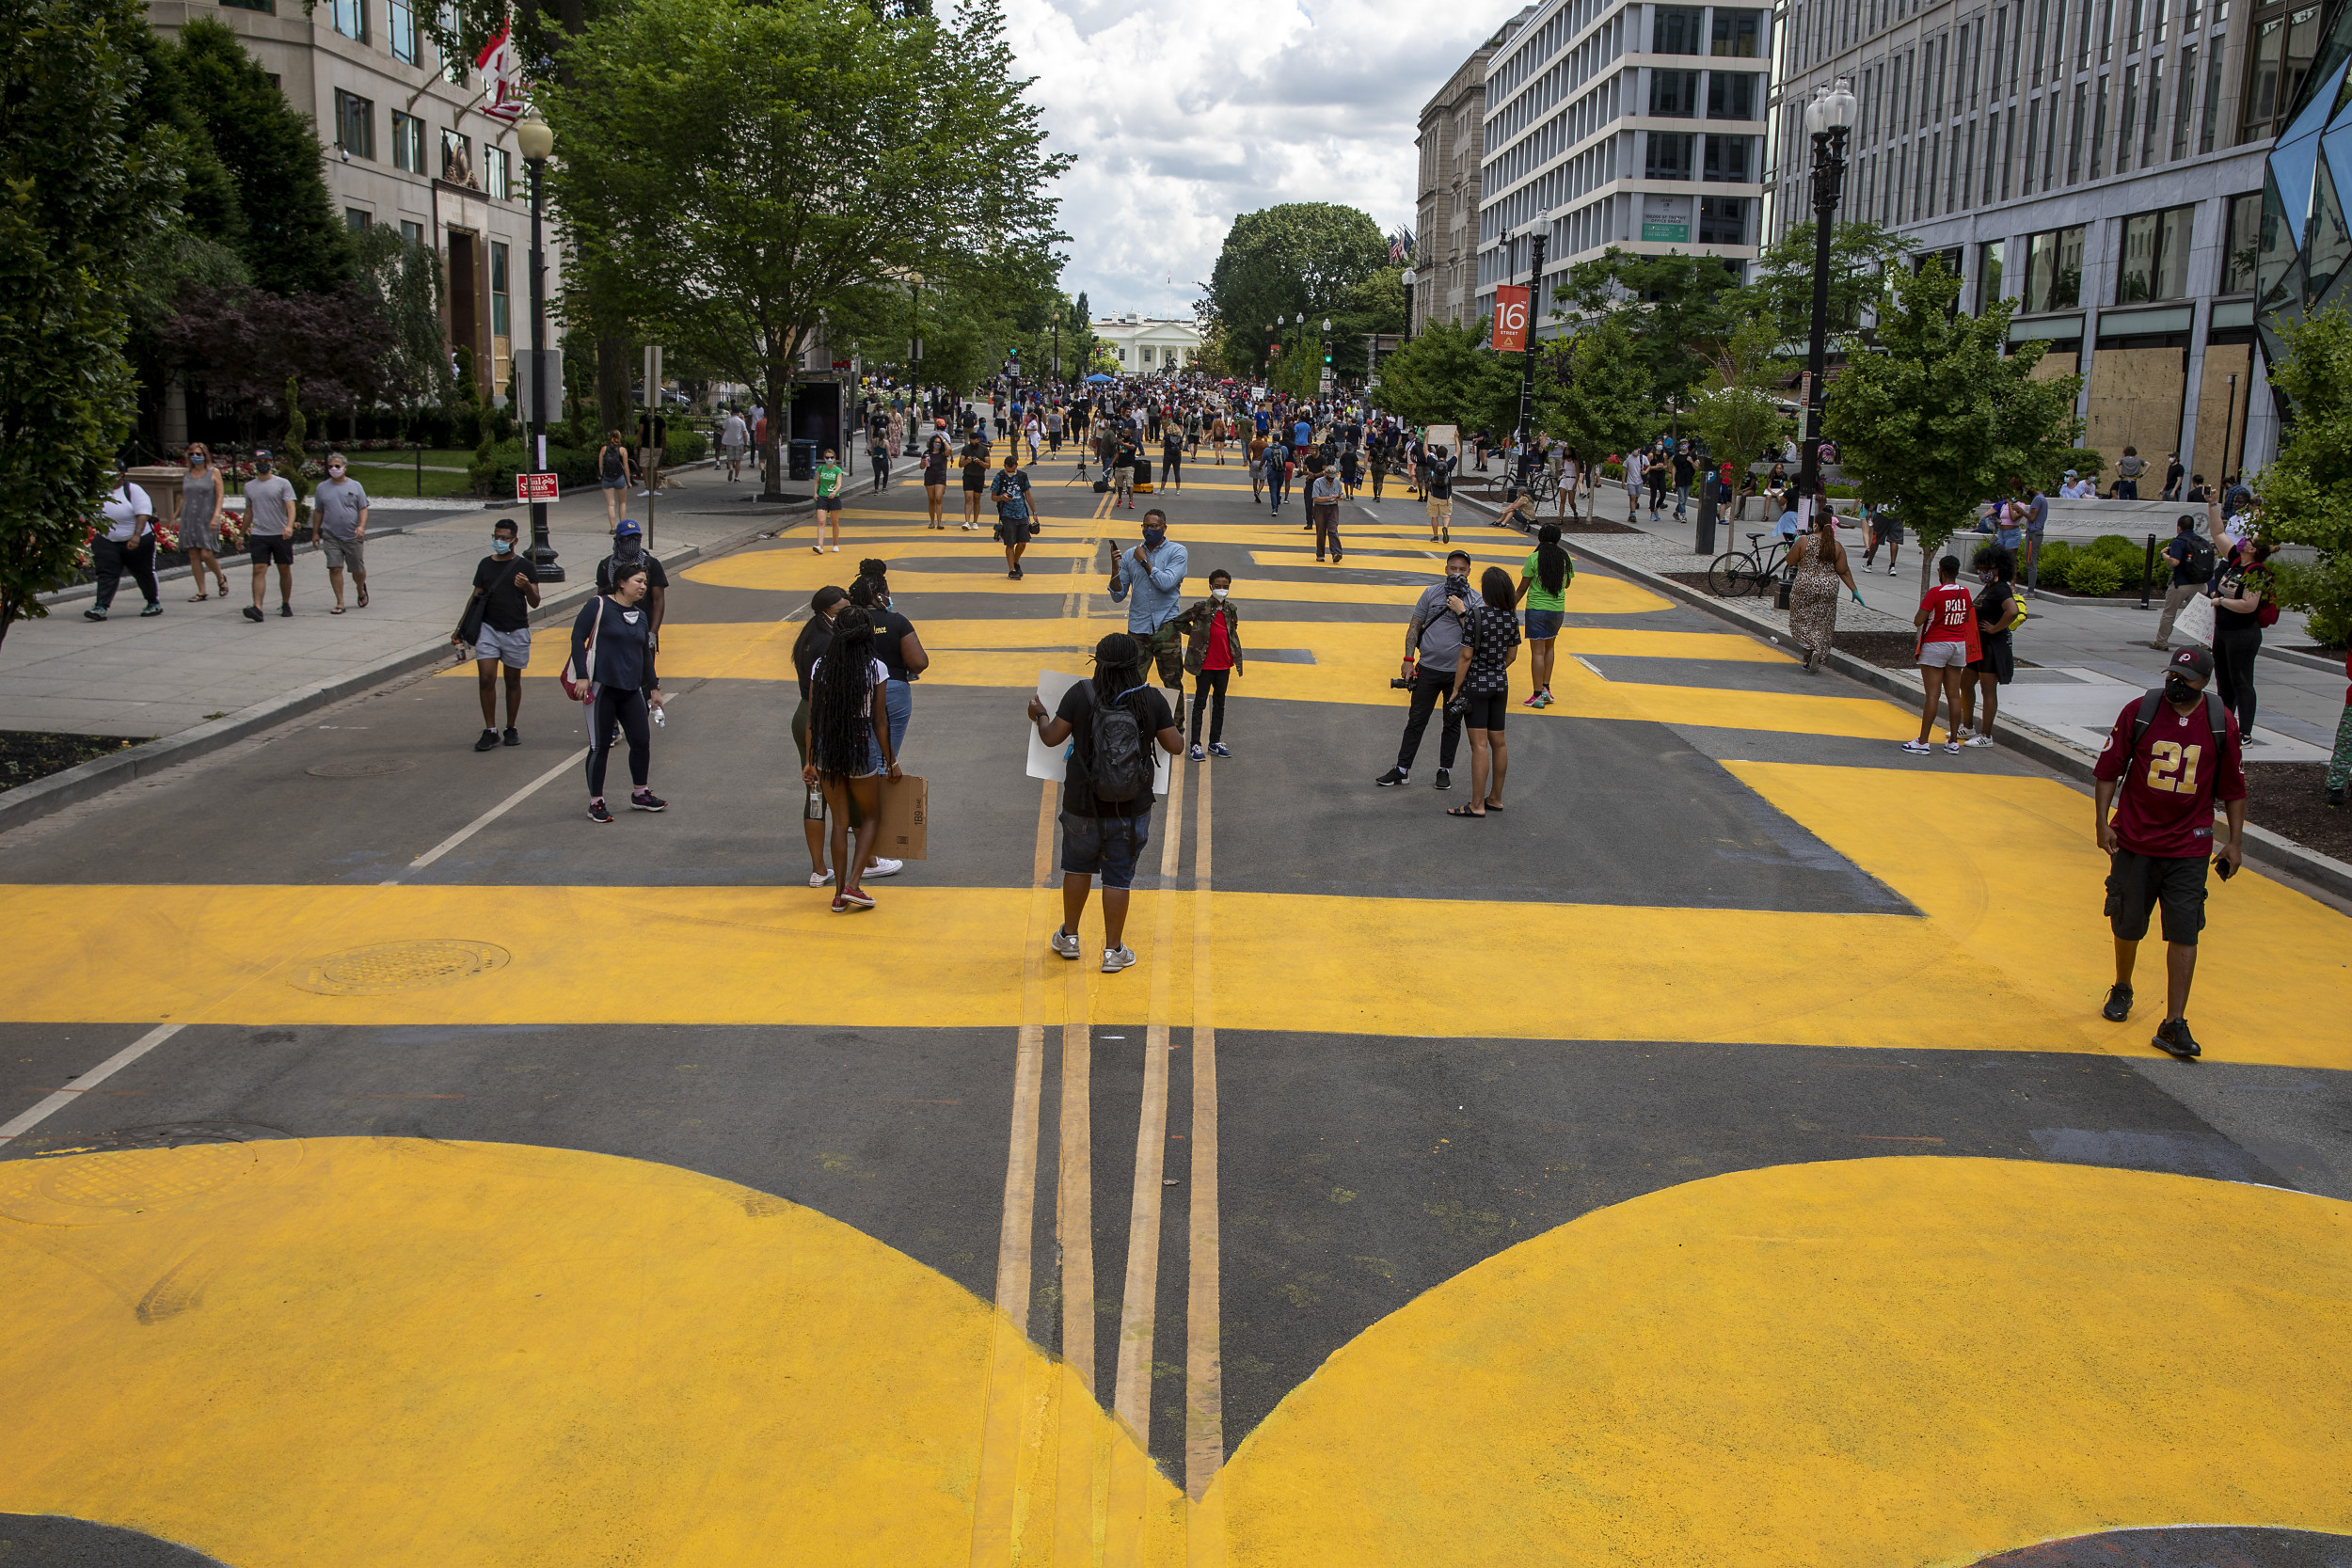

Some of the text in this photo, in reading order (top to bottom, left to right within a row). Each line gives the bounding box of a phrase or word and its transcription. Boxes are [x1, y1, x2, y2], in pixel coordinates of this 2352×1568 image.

[2067, 519, 2095, 528] CHURCH
[2134, 521, 2169, 531] SCIENTIST
[1945, 598, 1967, 612] ROLL
[1944, 611, 1966, 625] TIDE
[2147, 739, 2202, 795] 21
[914, 810, 923, 825] 1B9
